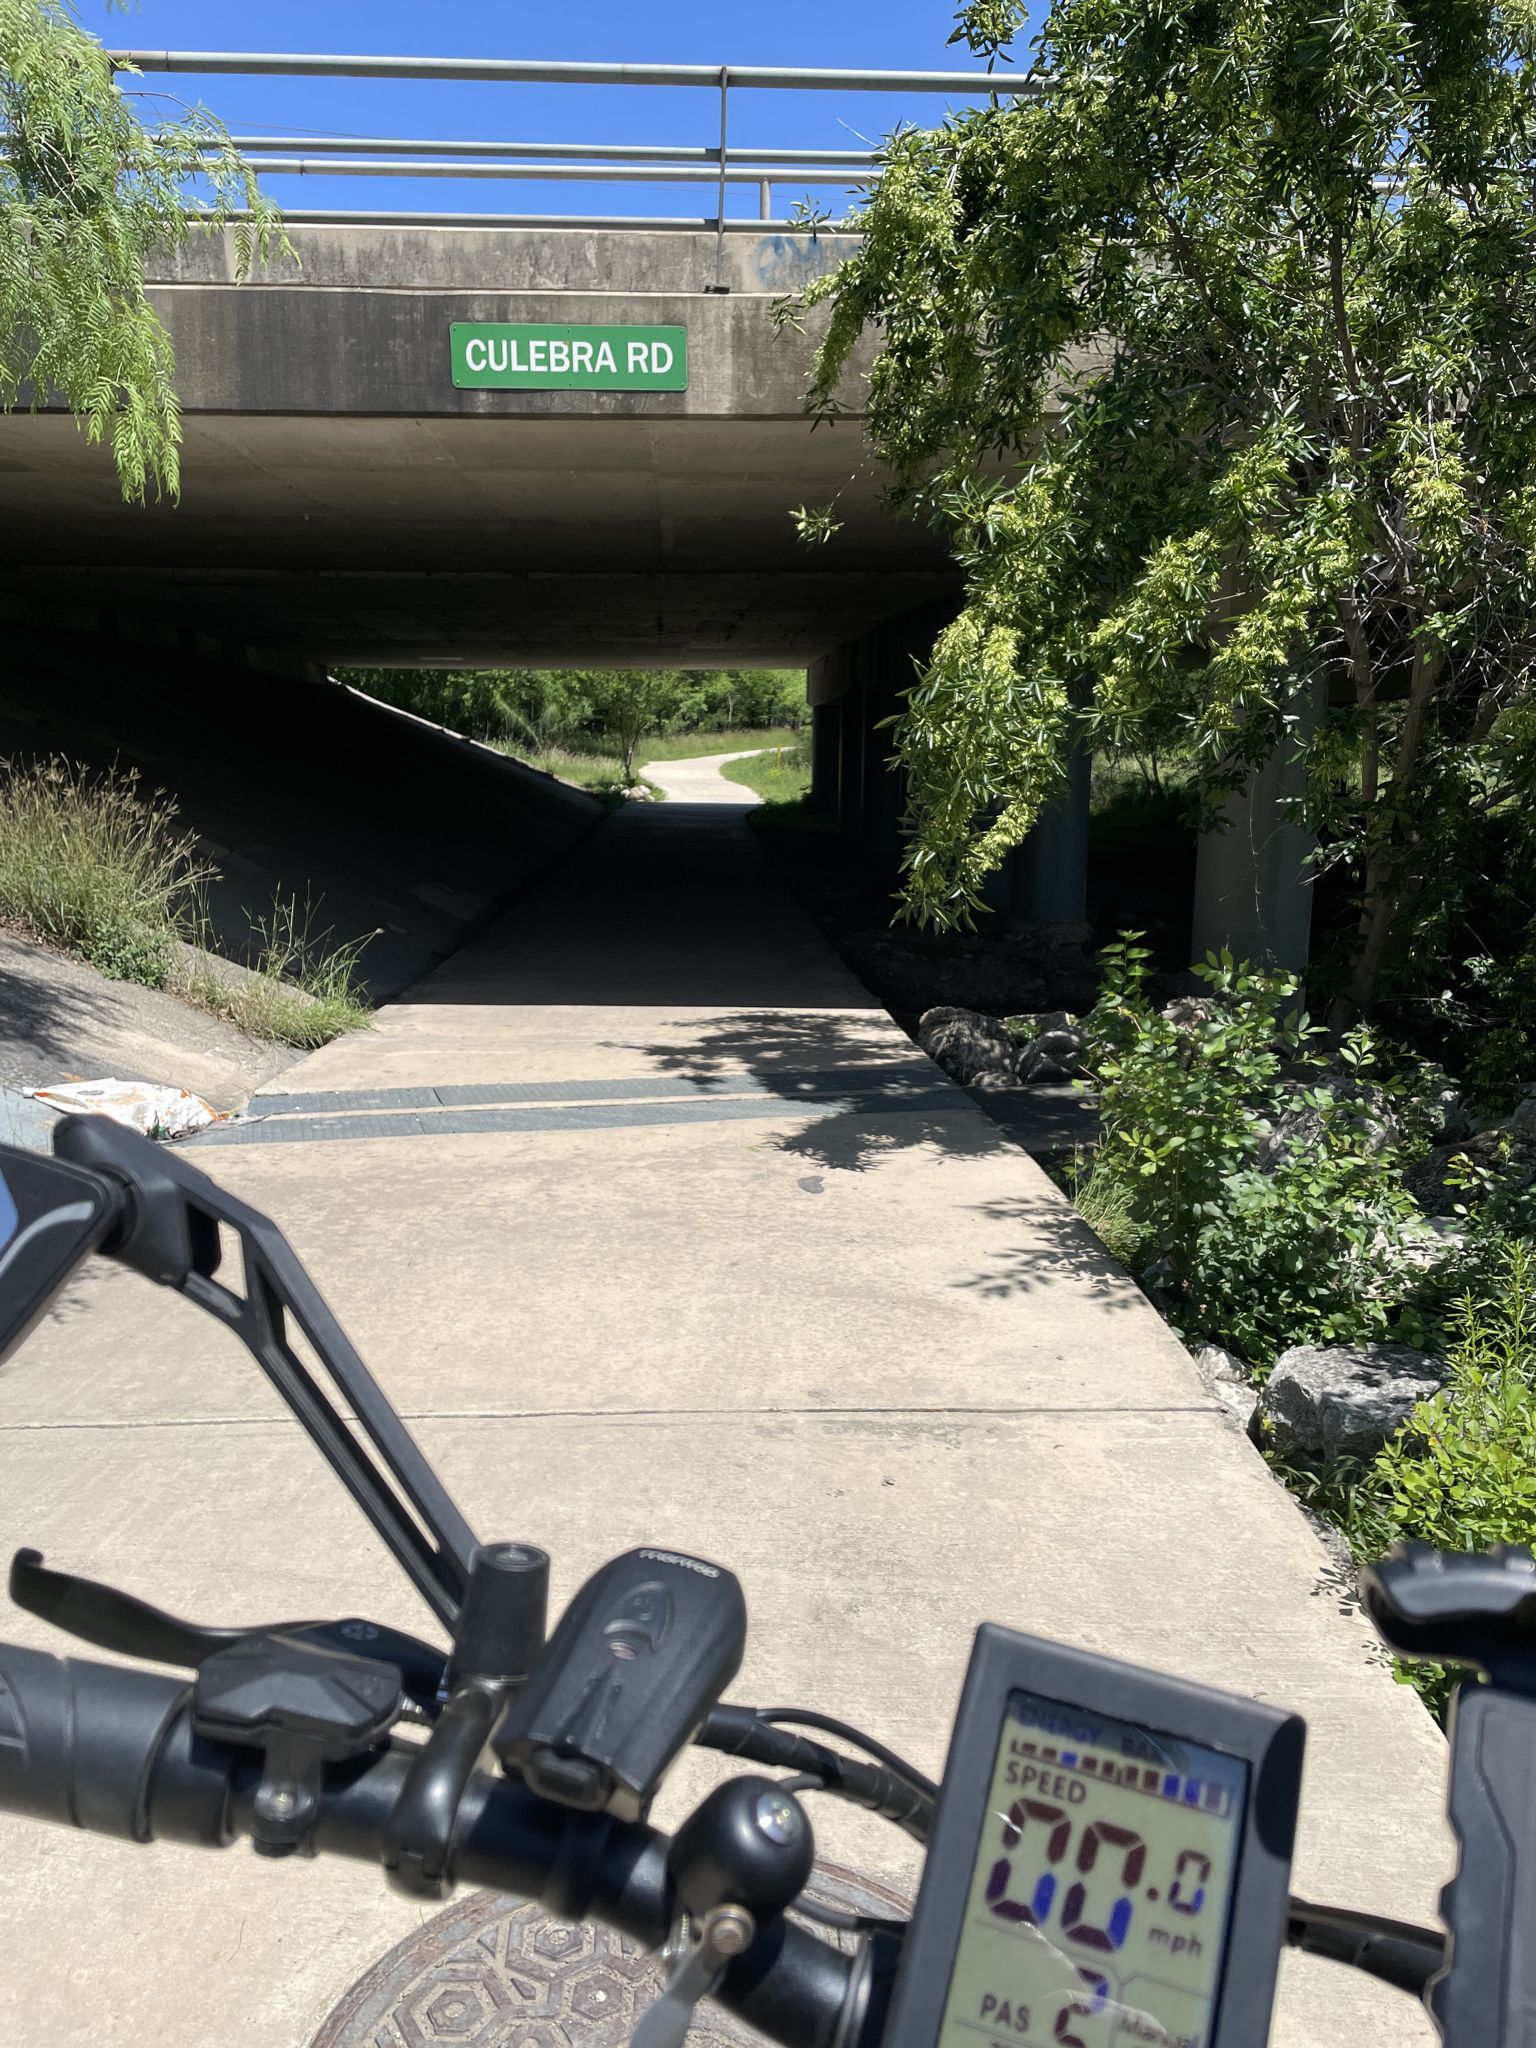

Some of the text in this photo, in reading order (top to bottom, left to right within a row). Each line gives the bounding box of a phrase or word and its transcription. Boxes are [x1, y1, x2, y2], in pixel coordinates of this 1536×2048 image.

[465, 339, 674, 374] CULEBRA RD
[1005, 1761, 1087, 1804] SPEED
[1147, 1926, 1203, 1957] mph
[980, 1993, 1031, 2033] PAS
